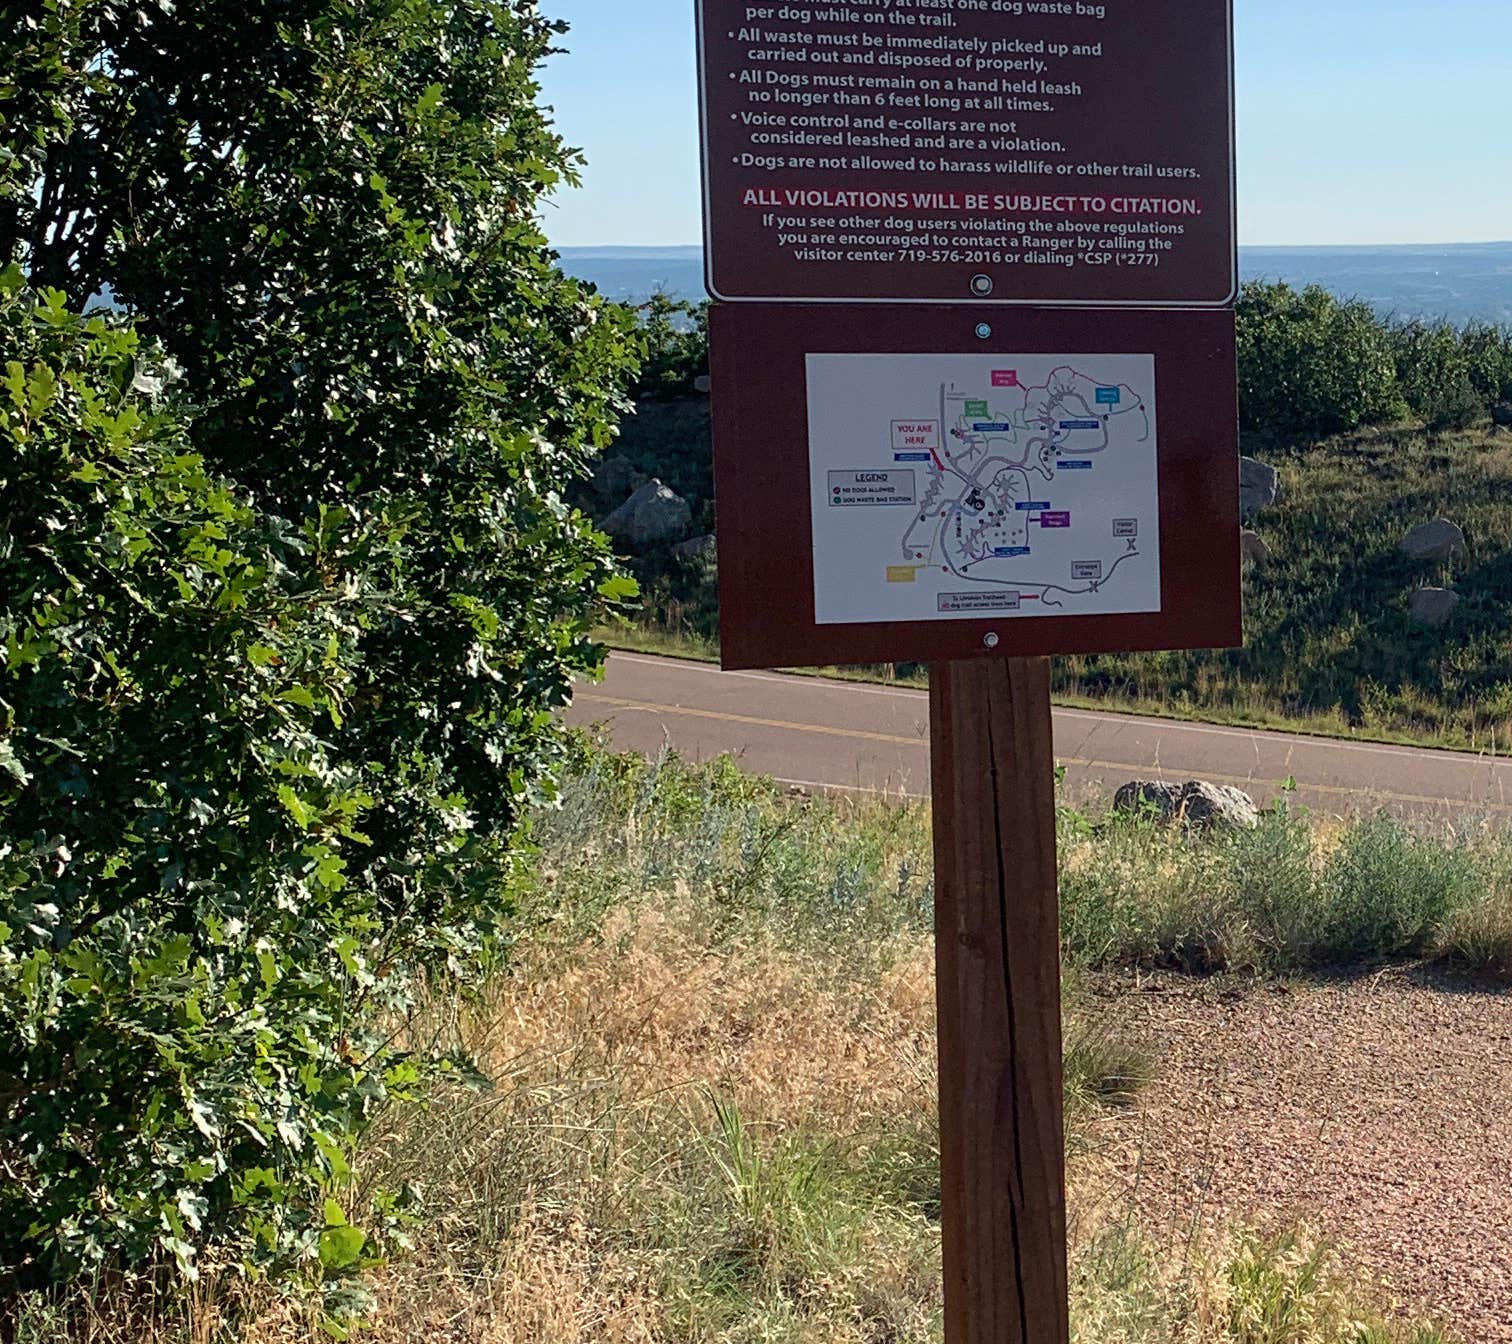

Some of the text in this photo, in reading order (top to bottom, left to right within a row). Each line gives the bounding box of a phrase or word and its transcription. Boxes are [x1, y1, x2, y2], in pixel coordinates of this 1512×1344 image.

[745, 5, 956, 26] per dog while the trail.
[957, 0, 987, 10] one
[1026, 2, 1072, 14] waste
[1076, 1, 1104, 18] bag
[737, 27, 1101, 57] All waste must be immediately picked up and
[747, 47, 1047, 74] carried out and disposed properly.
[739, 69, 1081, 94] All Dogs must remain hand held leash
[749, 88, 1054, 111] no longer than feet long all times.
[740, 111, 1016, 133] Voice control and e-collars are not
[750, 130, 1065, 151] considered leashed and are violation.
[741, 152, 1200, 178] Dogs are not allowed harass wildlife other trail users.
[743, 189, 1201, 214] ALL VIOLATIONS WILL BE SUBJECT TO CITATION.
[763, 213, 1184, 236] If you see other dog users violating the above regulations
[777, 233, 1172, 251] you are encouraged contact Ranger by calling the
[794, 247, 1073, 266] visitor center 719-576-2016 dialing
[898, 425, 915, 433] YOU
[905, 436, 926, 444] HERE
[855, 473, 888, 483] LEGEND
